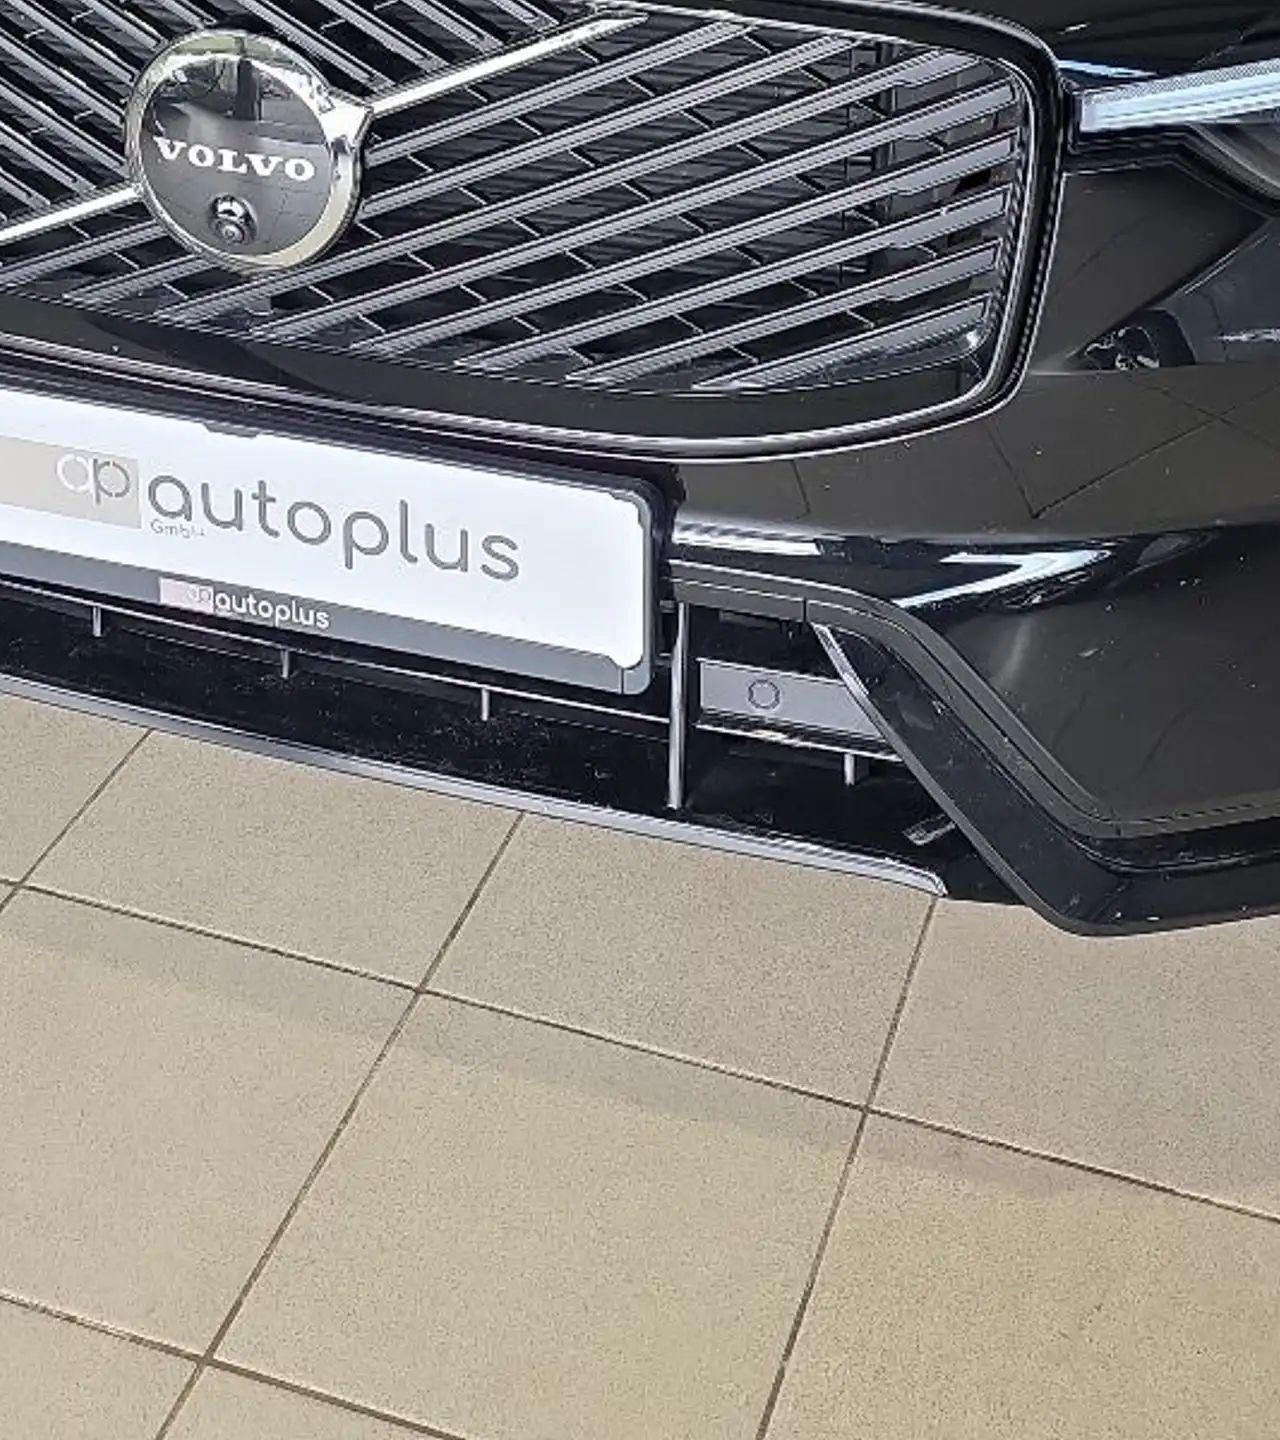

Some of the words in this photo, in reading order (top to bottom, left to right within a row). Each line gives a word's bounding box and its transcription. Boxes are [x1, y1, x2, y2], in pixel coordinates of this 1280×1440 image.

[153, 136, 315, 181] VOLVO
[148, 475, 520, 581] autoplus
[215, 591, 331, 629] autoplus
